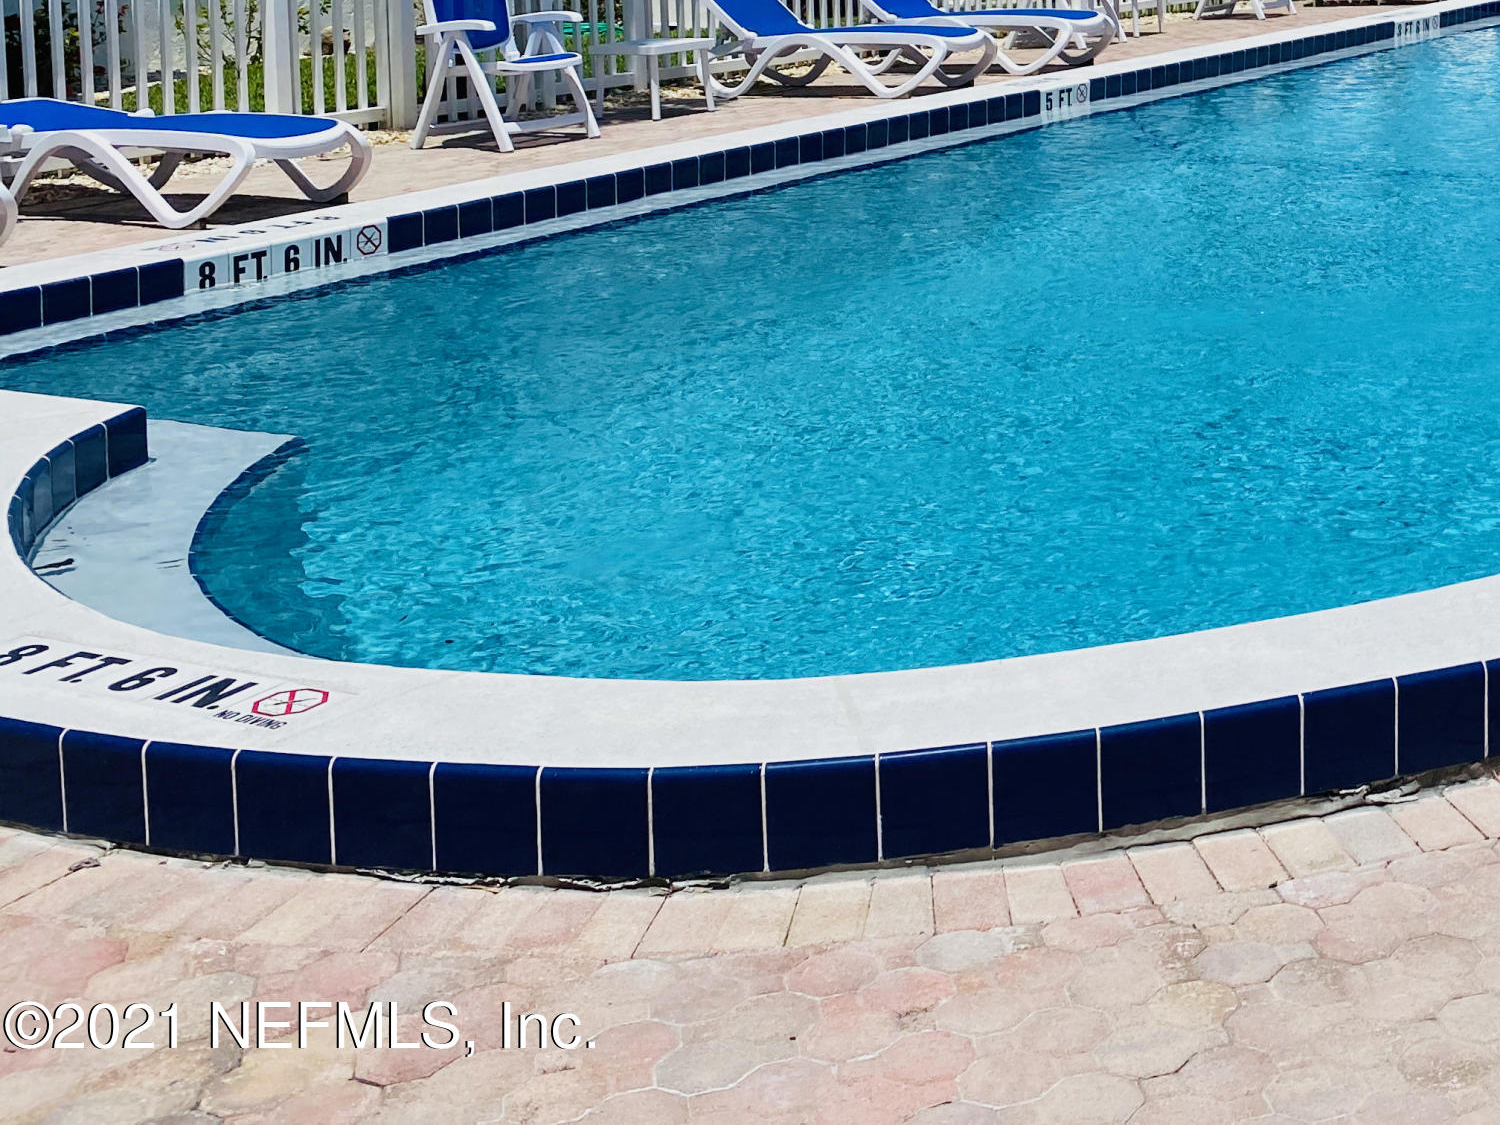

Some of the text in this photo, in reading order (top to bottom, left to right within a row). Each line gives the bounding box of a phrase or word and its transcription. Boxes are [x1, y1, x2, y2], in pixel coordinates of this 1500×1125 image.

[1045, 92, 1053, 111] 5
[198, 234, 348, 289] 8 FT. 6 IN.
[0, 644, 259, 711] 8 FT. 6 IN.
[213, 709, 288, 730] NO DIVING
